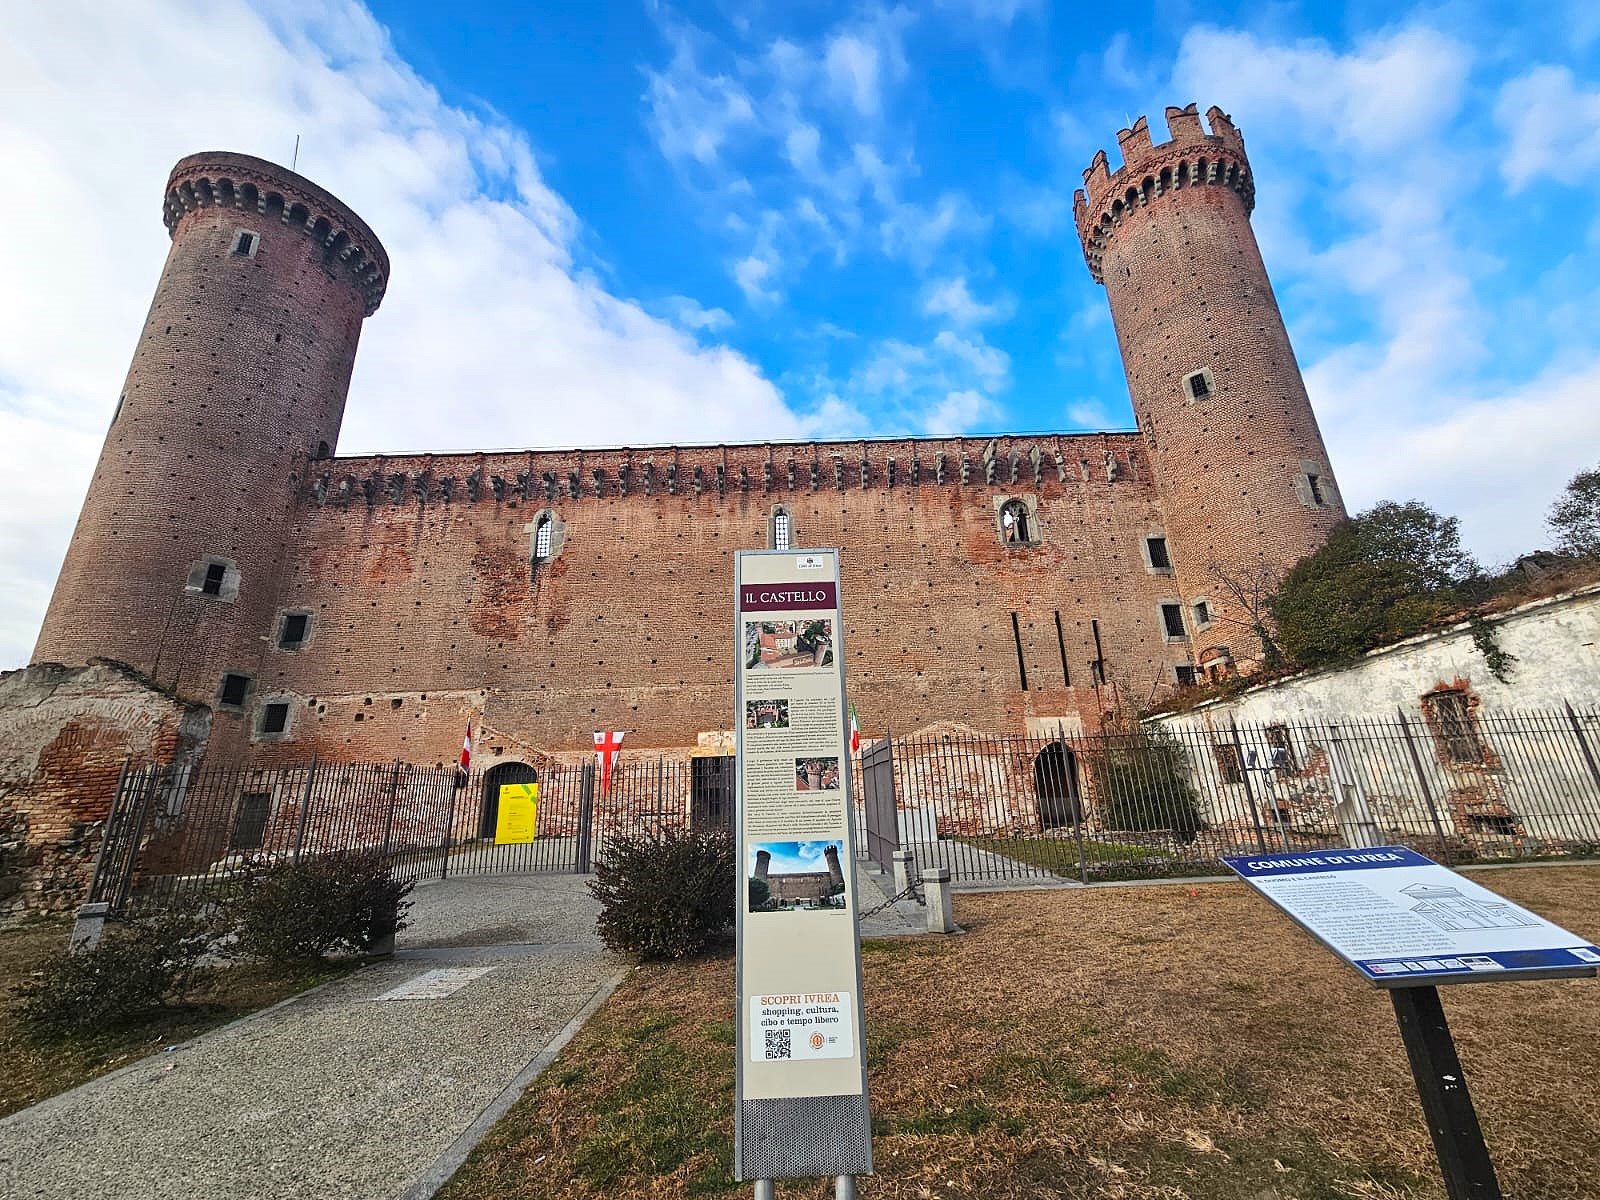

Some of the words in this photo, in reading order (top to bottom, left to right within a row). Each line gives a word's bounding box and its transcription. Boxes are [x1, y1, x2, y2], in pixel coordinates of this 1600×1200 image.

[745, 593, 757, 603] IL
[760, 591, 826, 603] CASTELLO
[1247, 857, 1327, 870] COMUNE
[1325, 856, 1351, 864] DI
[1346, 853, 1405, 863] IVREA
[761, 995, 801, 1005] SCOPRI
[804, 994, 840, 1004] IVREA
[762, 1007, 804, 1017] shopping,
[761, 1018, 778, 1026] cibo
[787, 1018, 813, 1026] tempo
[815, 1016, 839, 1024] libero
